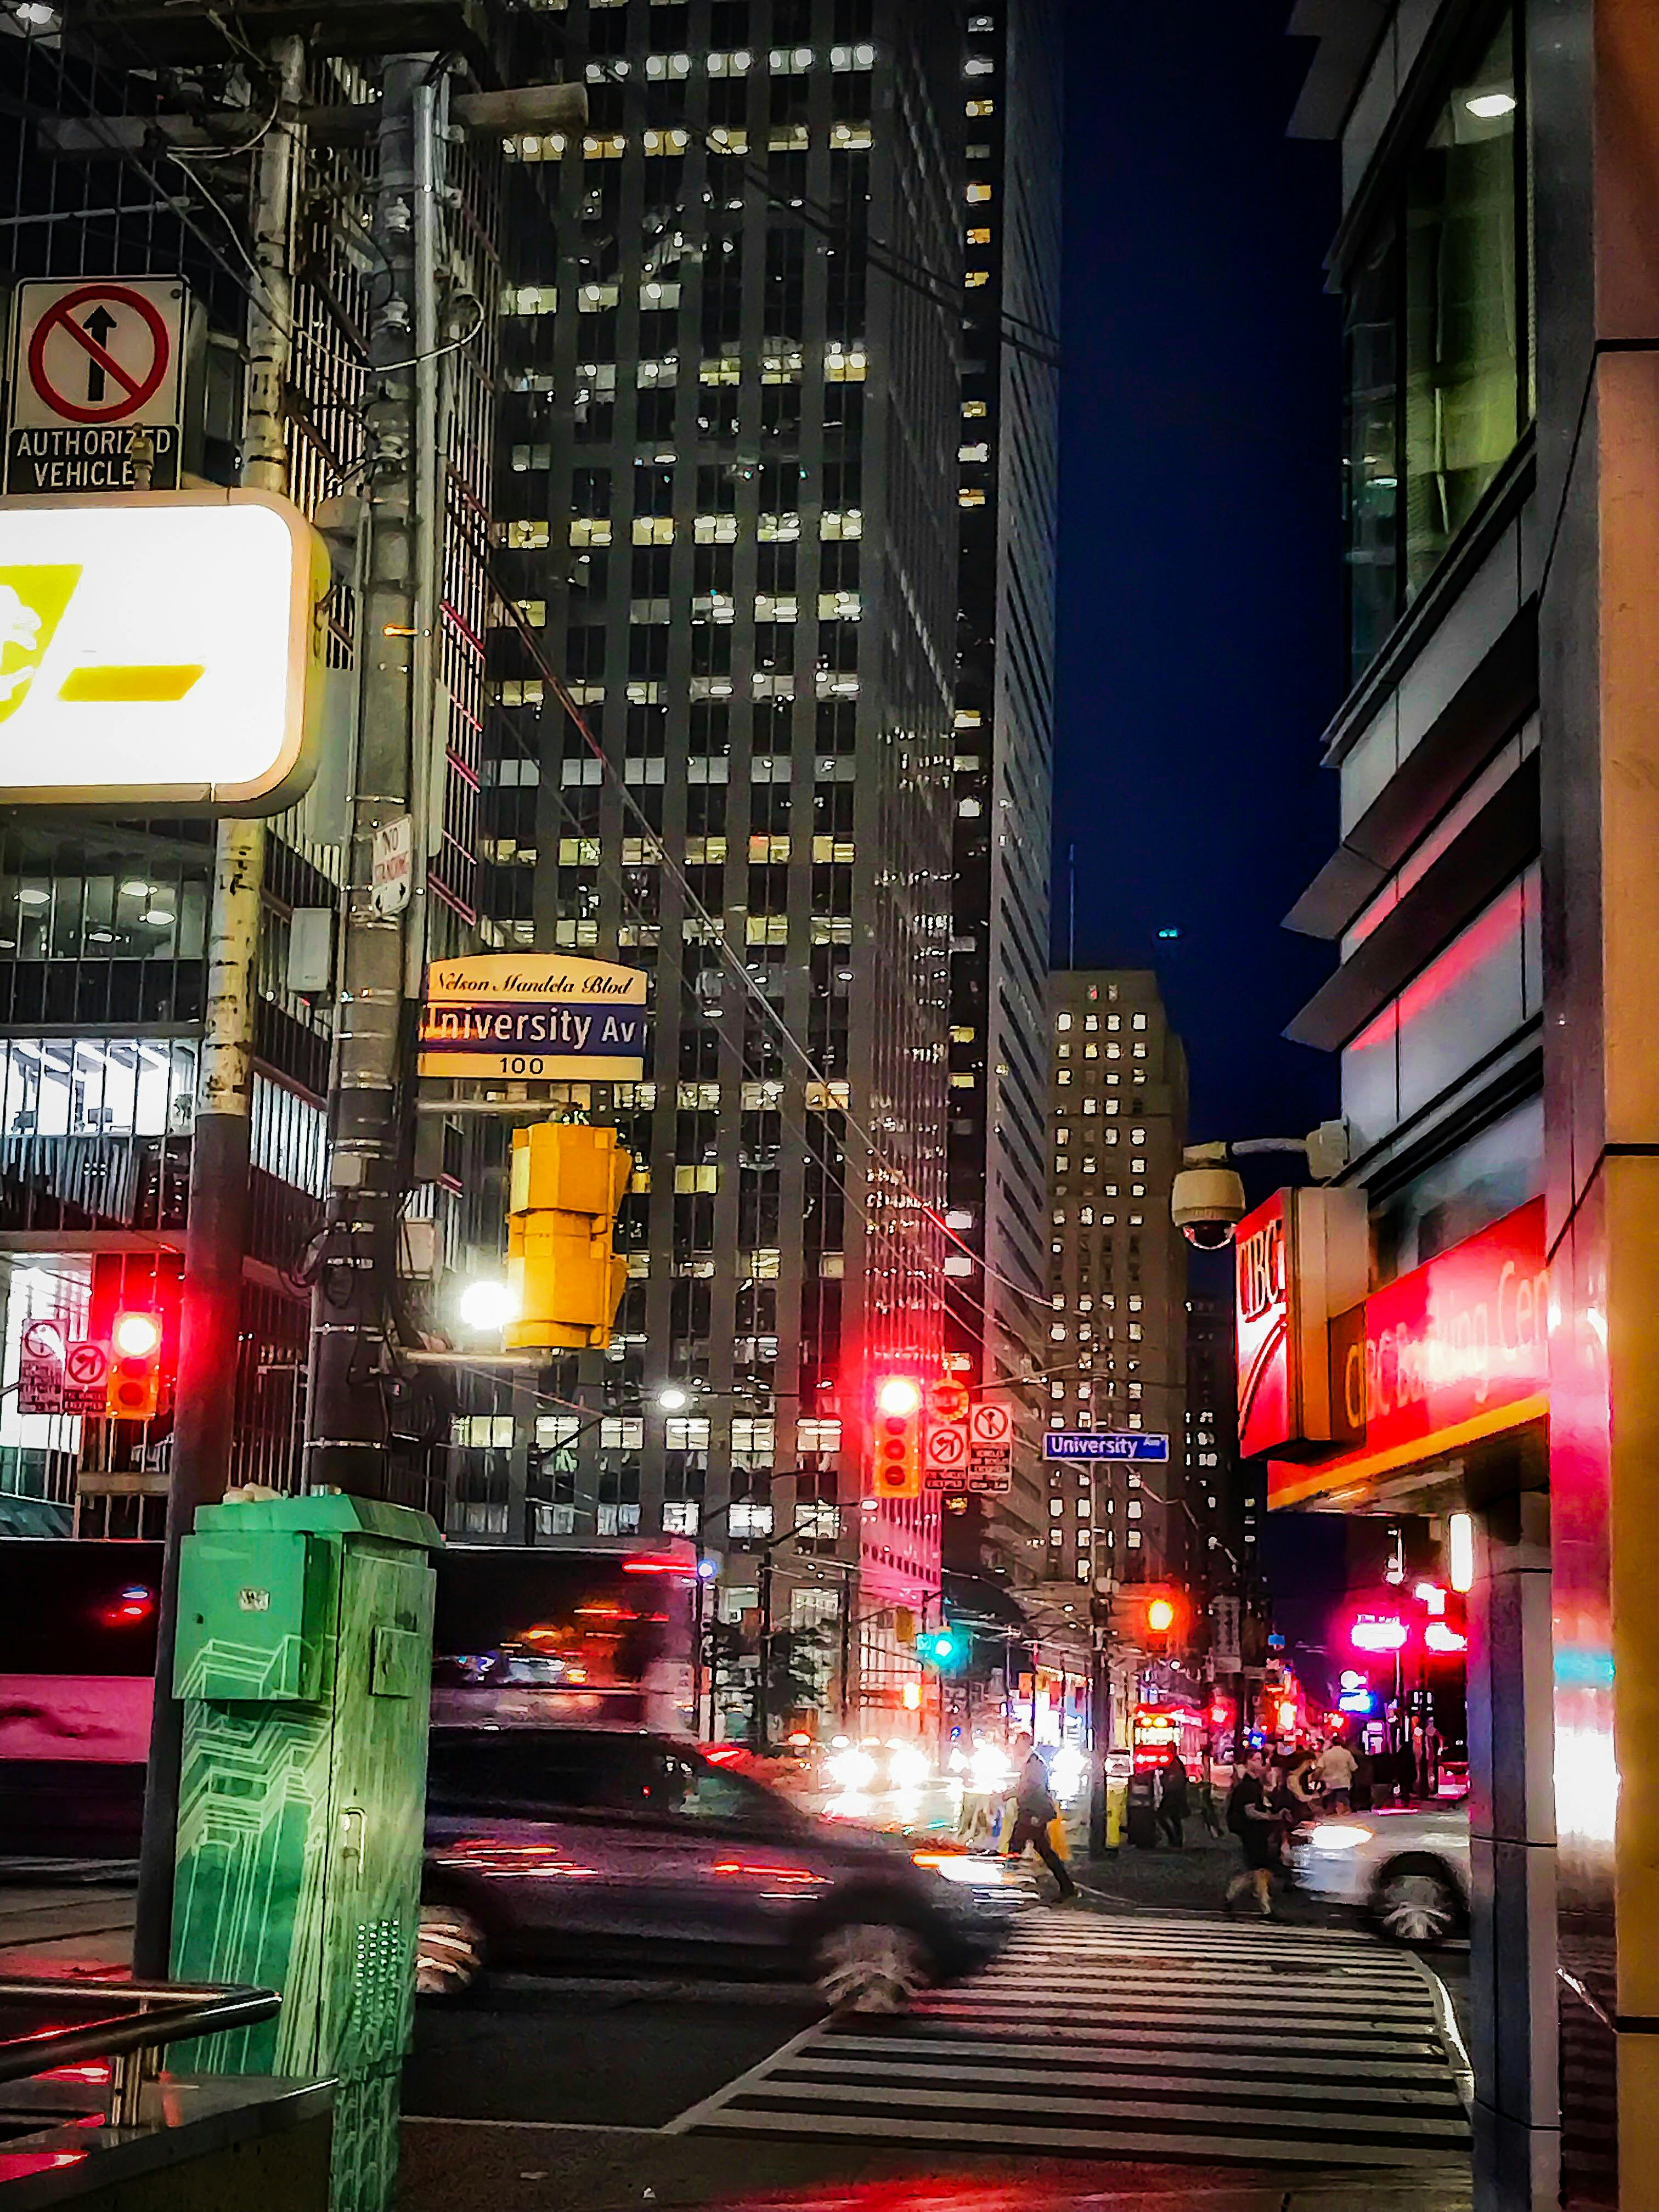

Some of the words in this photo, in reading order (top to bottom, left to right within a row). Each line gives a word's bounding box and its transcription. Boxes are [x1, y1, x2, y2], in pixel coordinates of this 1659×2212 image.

[16, 429, 171, 457] AUTHORIZD
[34, 460, 136, 487] VEHICLE
[438, 972, 490, 992] Nelson
[492, 973, 574, 993] Mandela
[601, 1015, 635, 1043] Av
[500, 1057, 544, 1075] 100
[1498, 1260, 1549, 1362] Cen
[1051, 1436, 1138, 1459] University
